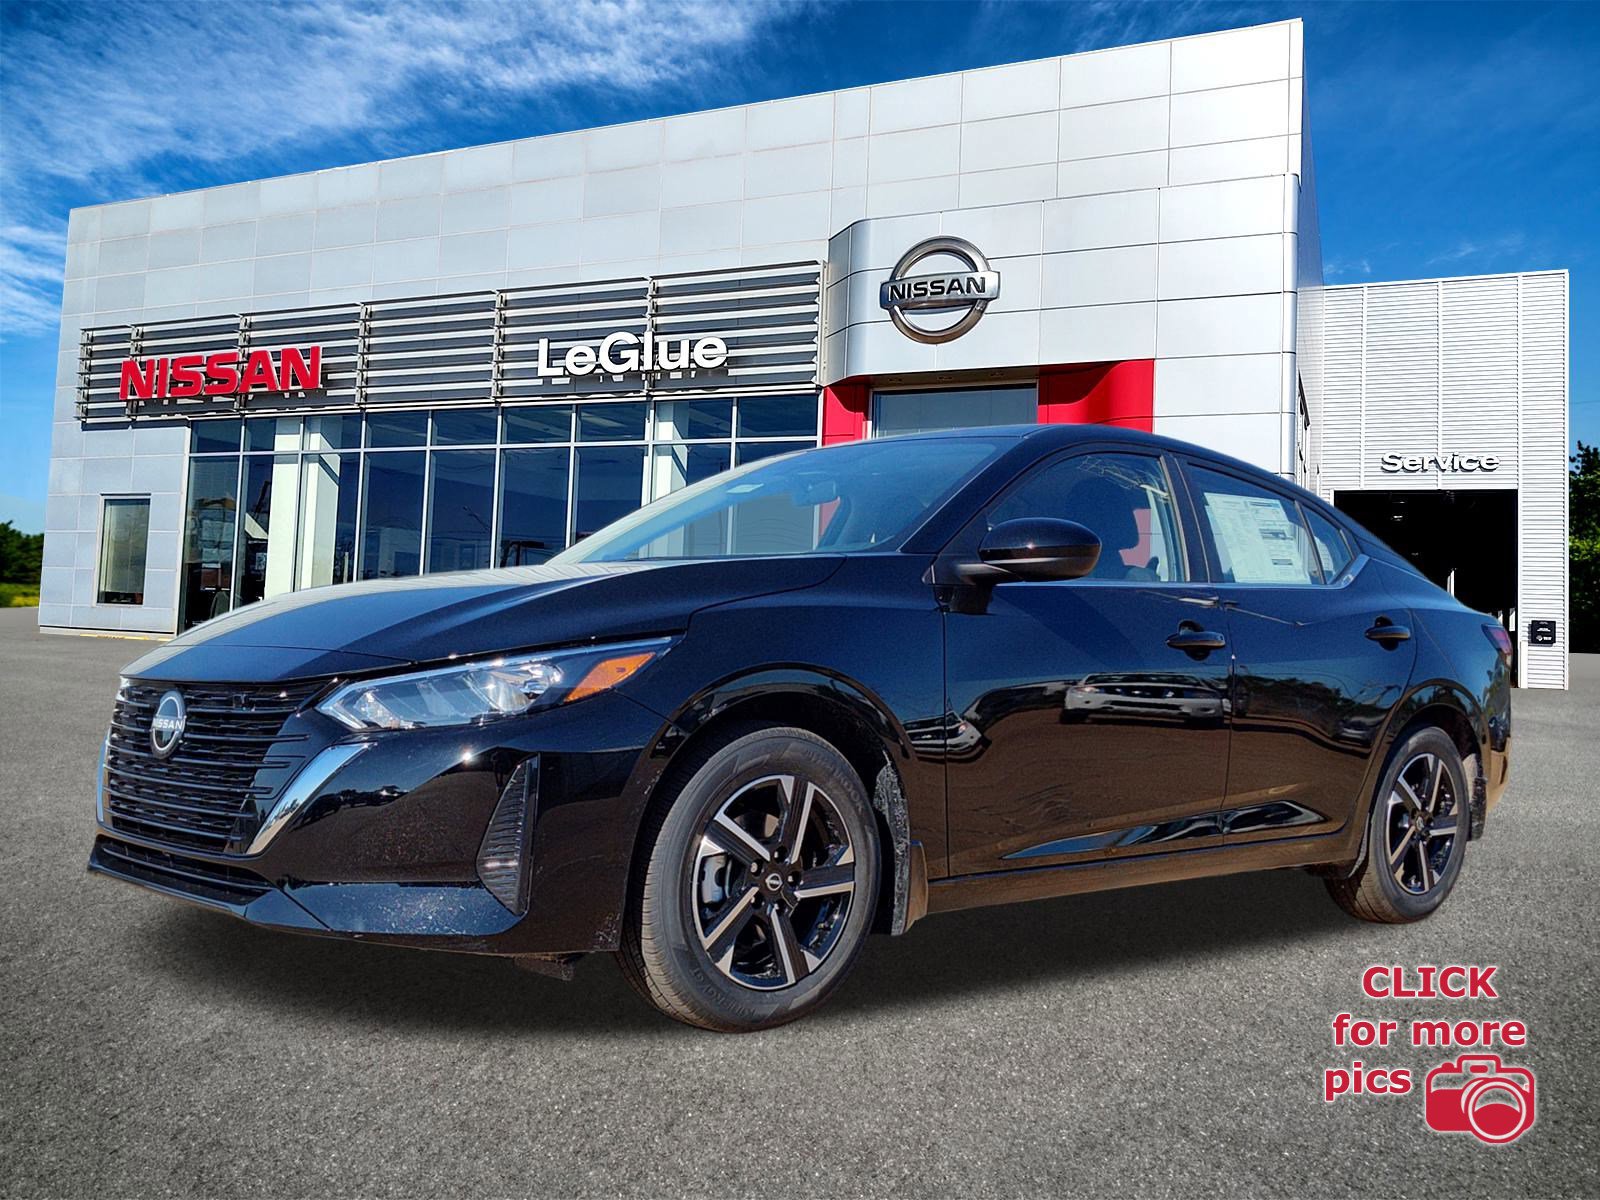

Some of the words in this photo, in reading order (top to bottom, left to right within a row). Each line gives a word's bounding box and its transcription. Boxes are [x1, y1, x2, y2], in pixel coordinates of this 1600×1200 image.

[888, 277, 986, 301] NISSAN
[537, 331, 728, 377] LeGlue
[119, 345, 322, 400] NISSAN
[1381, 451, 1499, 473] Service
